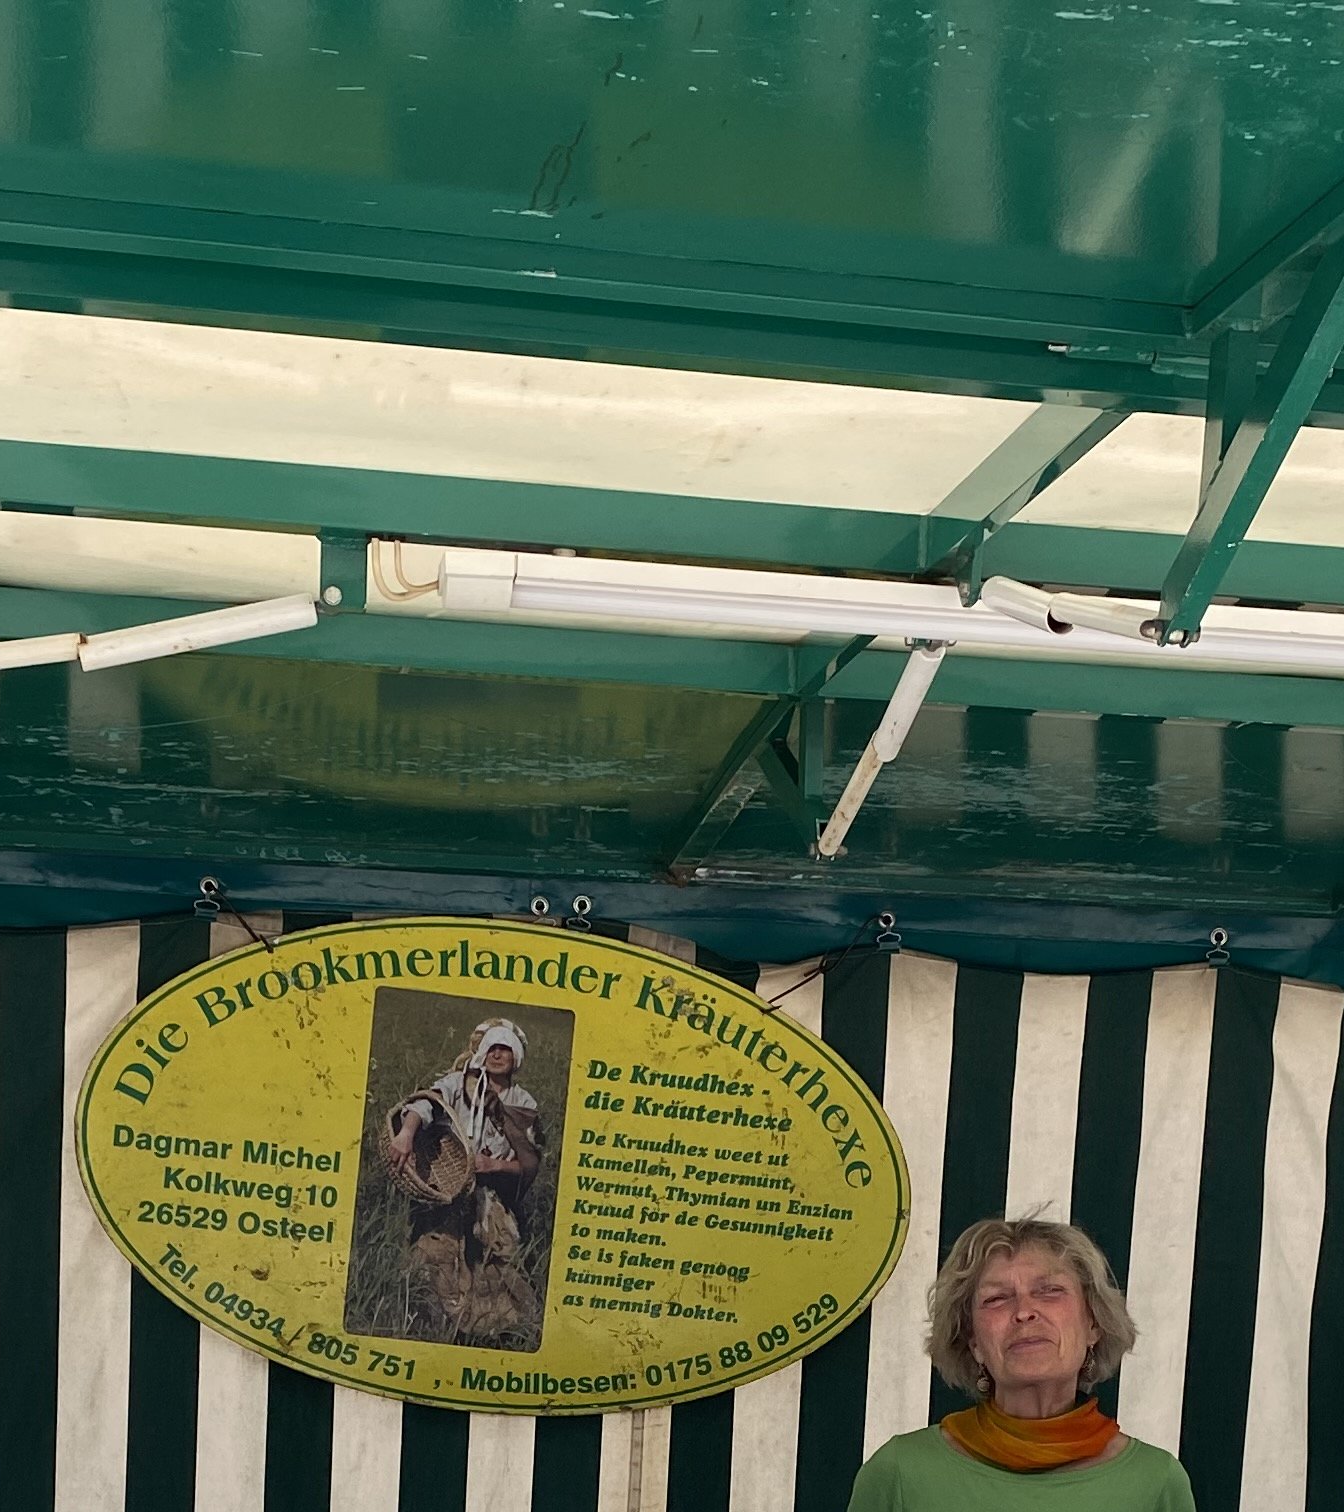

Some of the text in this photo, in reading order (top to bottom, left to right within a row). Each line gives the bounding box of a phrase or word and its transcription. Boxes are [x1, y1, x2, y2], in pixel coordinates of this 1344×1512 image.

[113, 939, 873, 1189] Die Brookmerlander Kräuterhexe
[587, 1059, 754, 1096] De Kruudhex
[584, 1090, 793, 1132] die Kräuterhexe
[112, 1124, 342, 1173] Dagmar Michel
[577, 1153, 676, 1181] Kamellen,
[579, 1129, 789, 1167] De Kruudhex weet ut
[163, 1166, 338, 1209] Kolkweg 10
[576, 1176, 853, 1221] Wermut, Thymian un Enzian
[137, 1200, 334, 1243] 26529 Osteel
[571, 1222, 667, 1247] to maken.
[573, 1199, 834, 1242] Kruud de Gesunnigkeit
[565, 1267, 656, 1292] künniger
[568, 1245, 750, 1282] Se is faken genoog
[158, 1243, 199, 1290] Tel.
[204, 1281, 286, 1339] 04934
[306, 1332, 360, 1366] 805
[366, 1349, 416, 1381] 751
[562, 1293, 739, 1324] as mennig Dokter.
[460, 1292, 840, 1395] Mobilbesen: 0175 88 09 529
